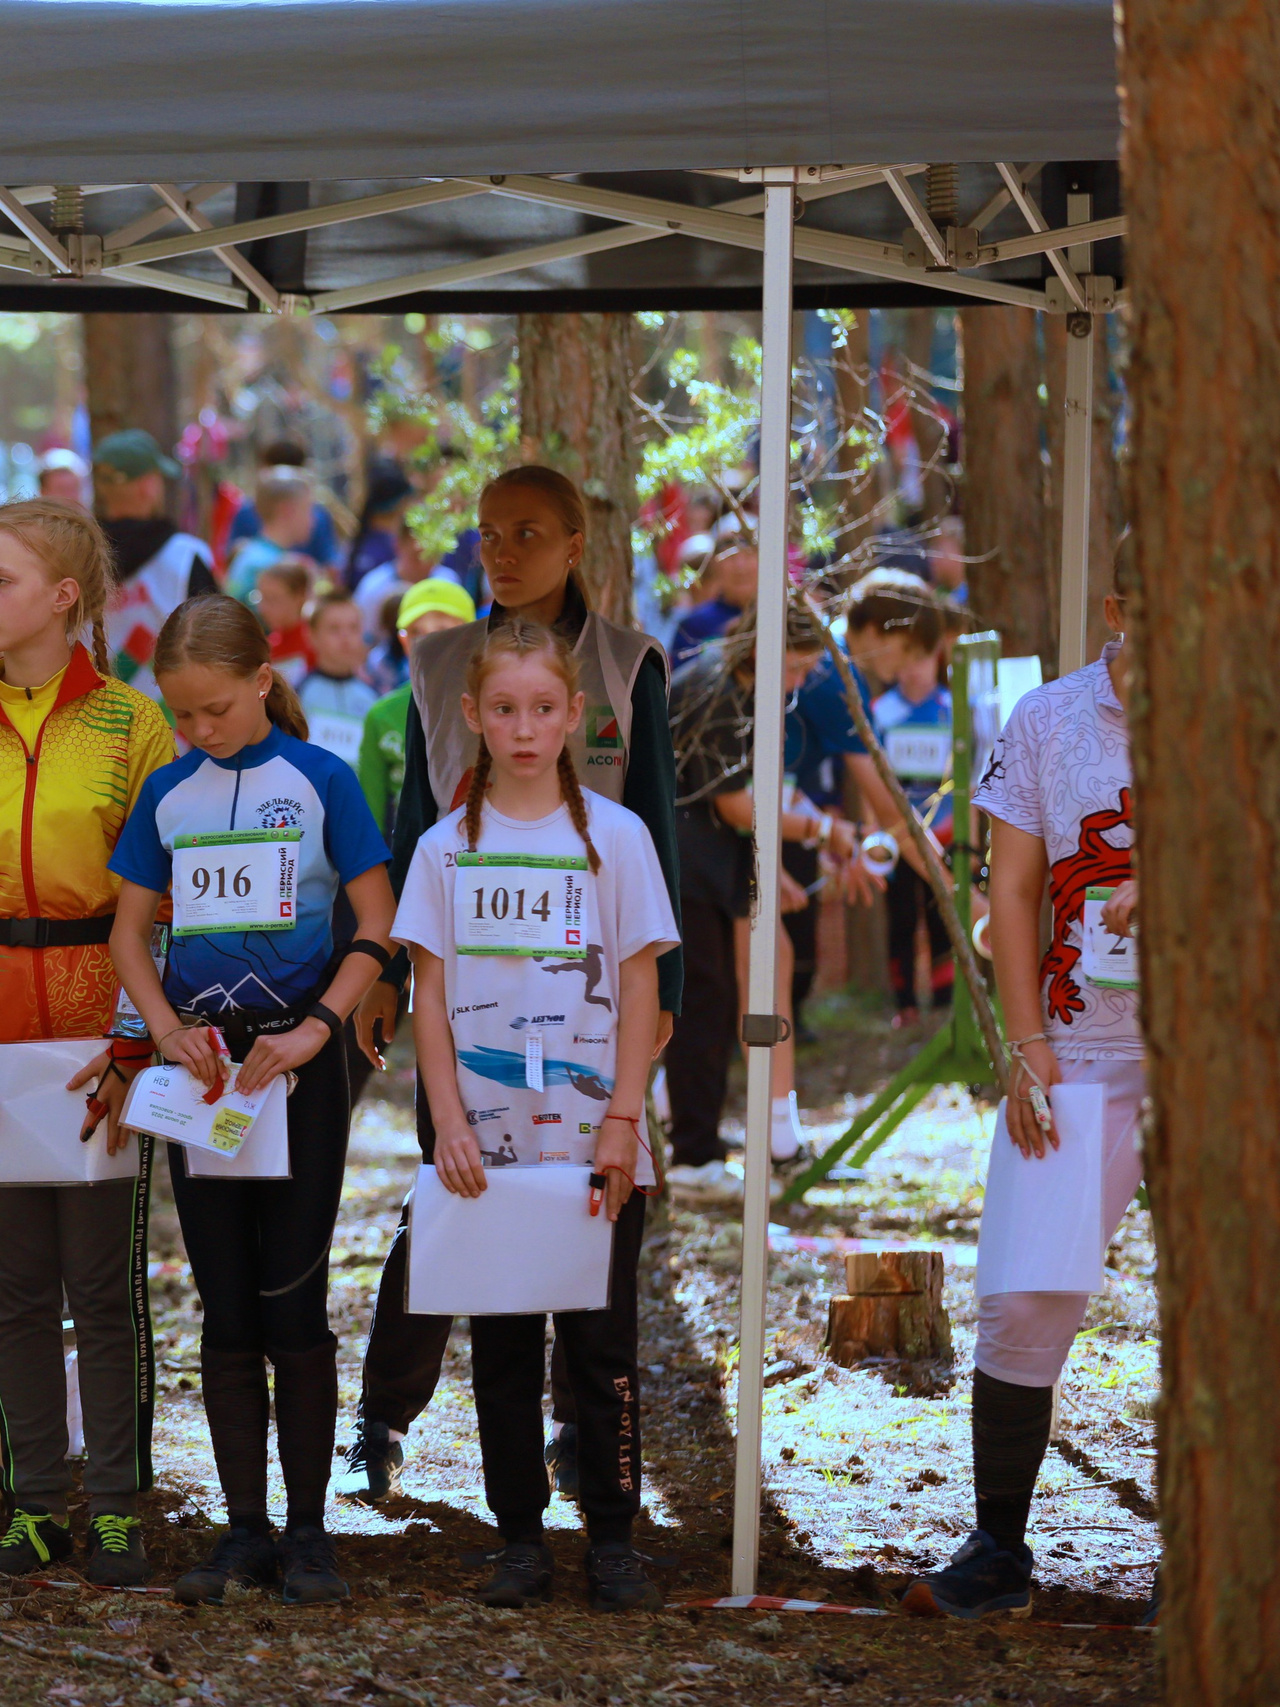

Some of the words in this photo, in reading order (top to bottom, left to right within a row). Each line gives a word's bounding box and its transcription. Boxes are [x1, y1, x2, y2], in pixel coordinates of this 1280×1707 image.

[255, 797, 305, 815] ЭДЕЛЬВЕЙС
[192, 864, 251, 900] 916
[278, 847, 287, 897] ПЕРМСКИЙ
[287, 859, 295, 897] ПЕРИОД
[472, 887, 551, 922] 1014
[565, 875, 574, 925] ПЕРМСКИЙ
[574, 888, 582, 926] ПЕРИОД
[472, 1002, 498, 1012] Cement
[140, 1361, 147, 1373] FU
[613, 1376, 634, 1438] ENOY
